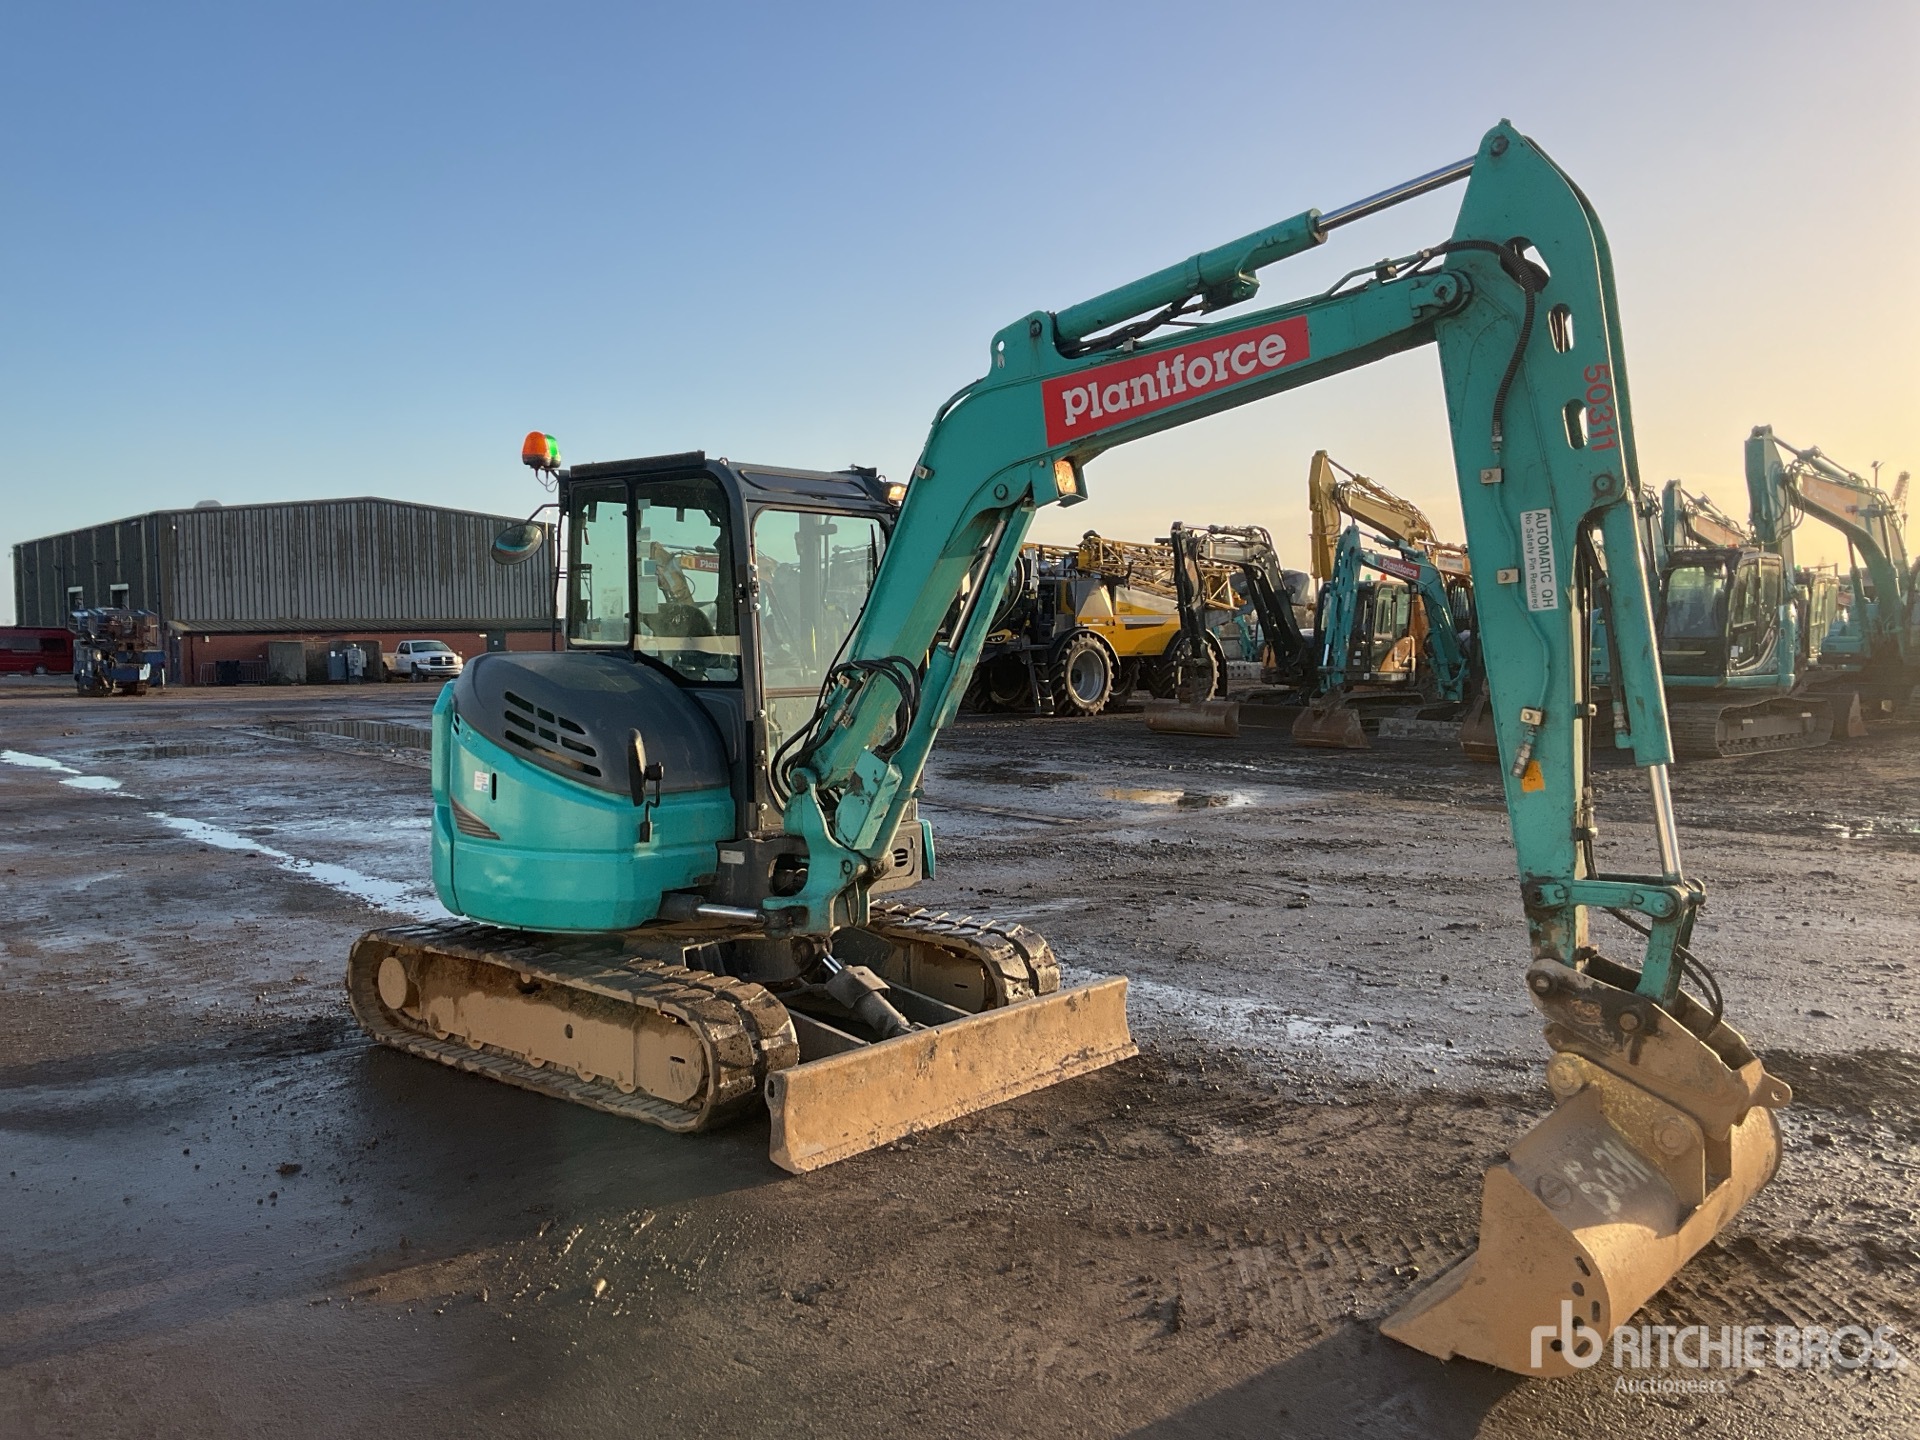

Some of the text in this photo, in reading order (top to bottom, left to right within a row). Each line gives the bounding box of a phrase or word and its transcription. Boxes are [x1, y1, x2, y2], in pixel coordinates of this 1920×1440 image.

[1062, 333, 1287, 426] plantforce
[1583, 363, 1616, 451] 50311
[1525, 513, 1532, 524] No
[1526, 528, 1534, 554] Safety
[1535, 512, 1554, 607] AUTOMATIC QH
[1530, 573, 1539, 609] Required
